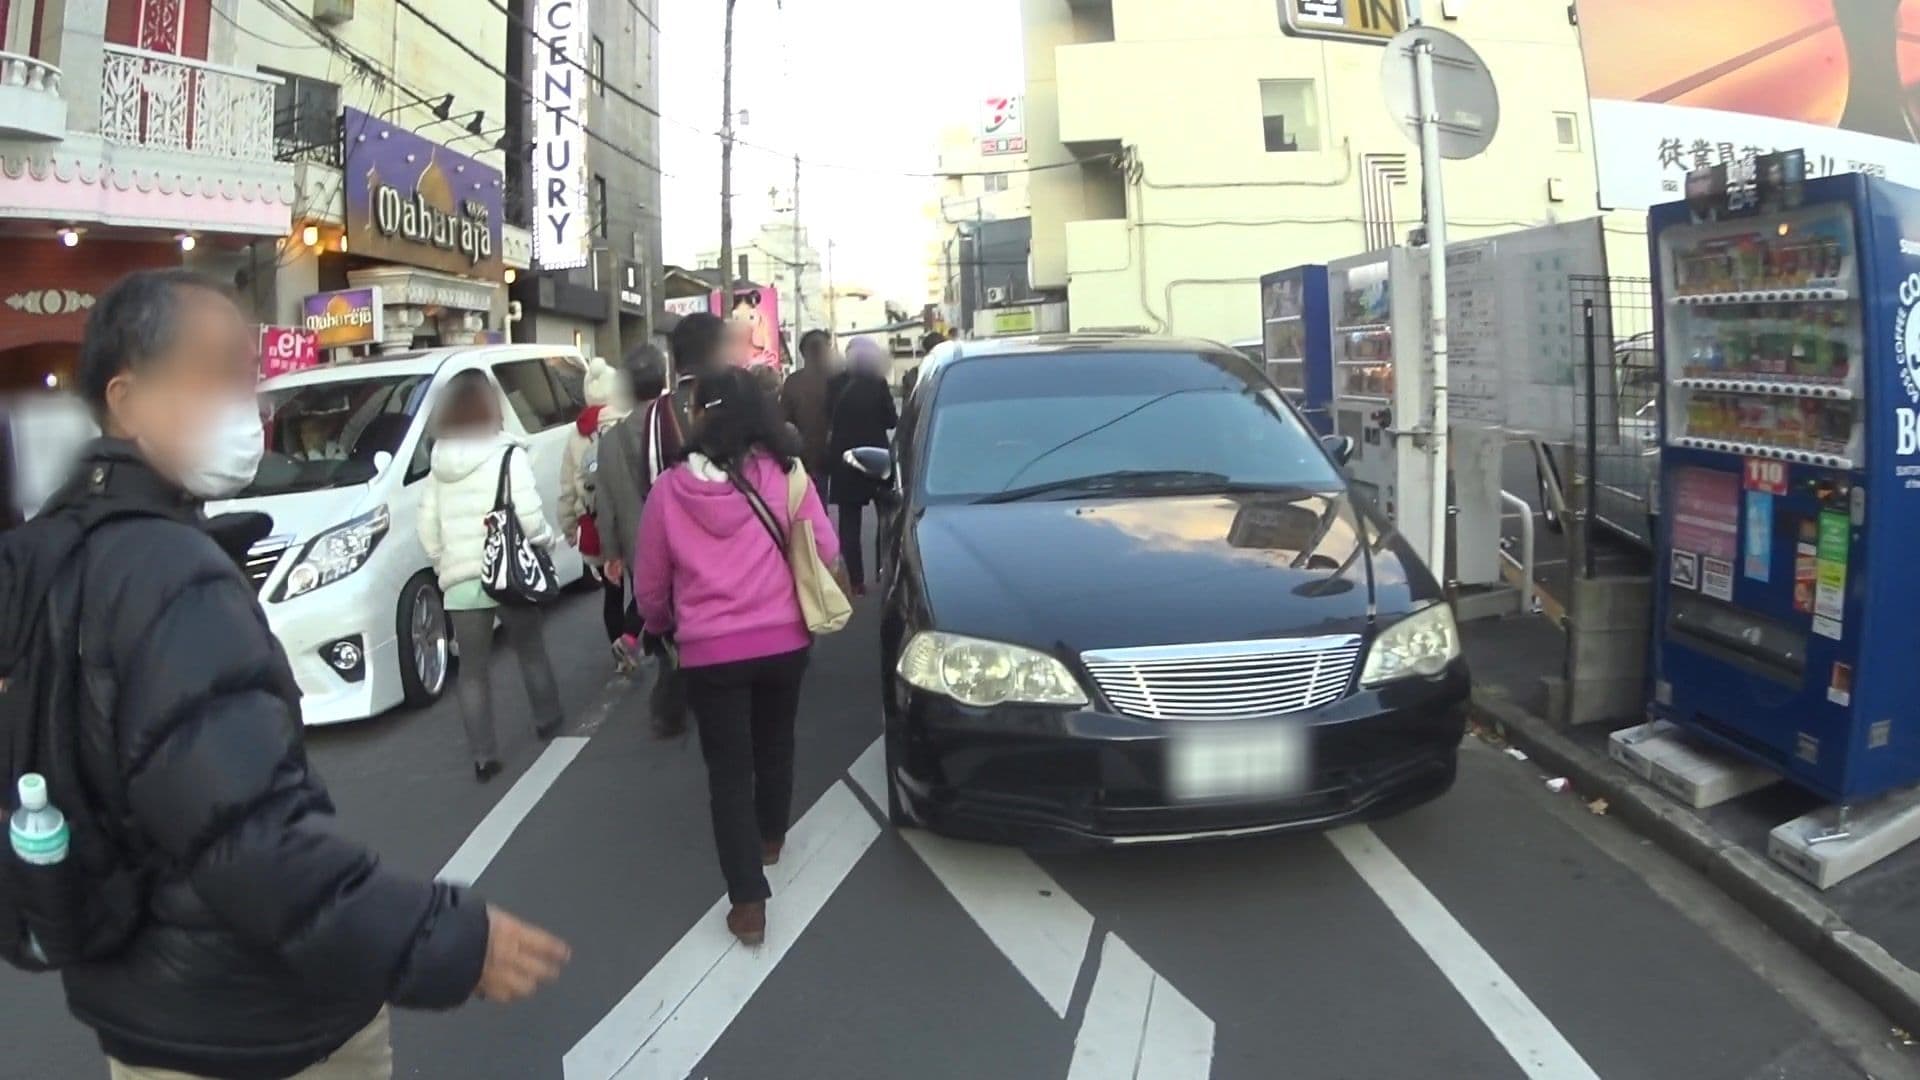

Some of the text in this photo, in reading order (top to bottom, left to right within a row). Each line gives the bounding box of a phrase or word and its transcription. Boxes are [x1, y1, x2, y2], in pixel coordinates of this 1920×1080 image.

[1358, 0, 1401, 32] IN
[545, 2, 571, 244] CENTURY
[379, 185, 491, 263] Maharaja
[1750, 460, 1784, 484] 110
